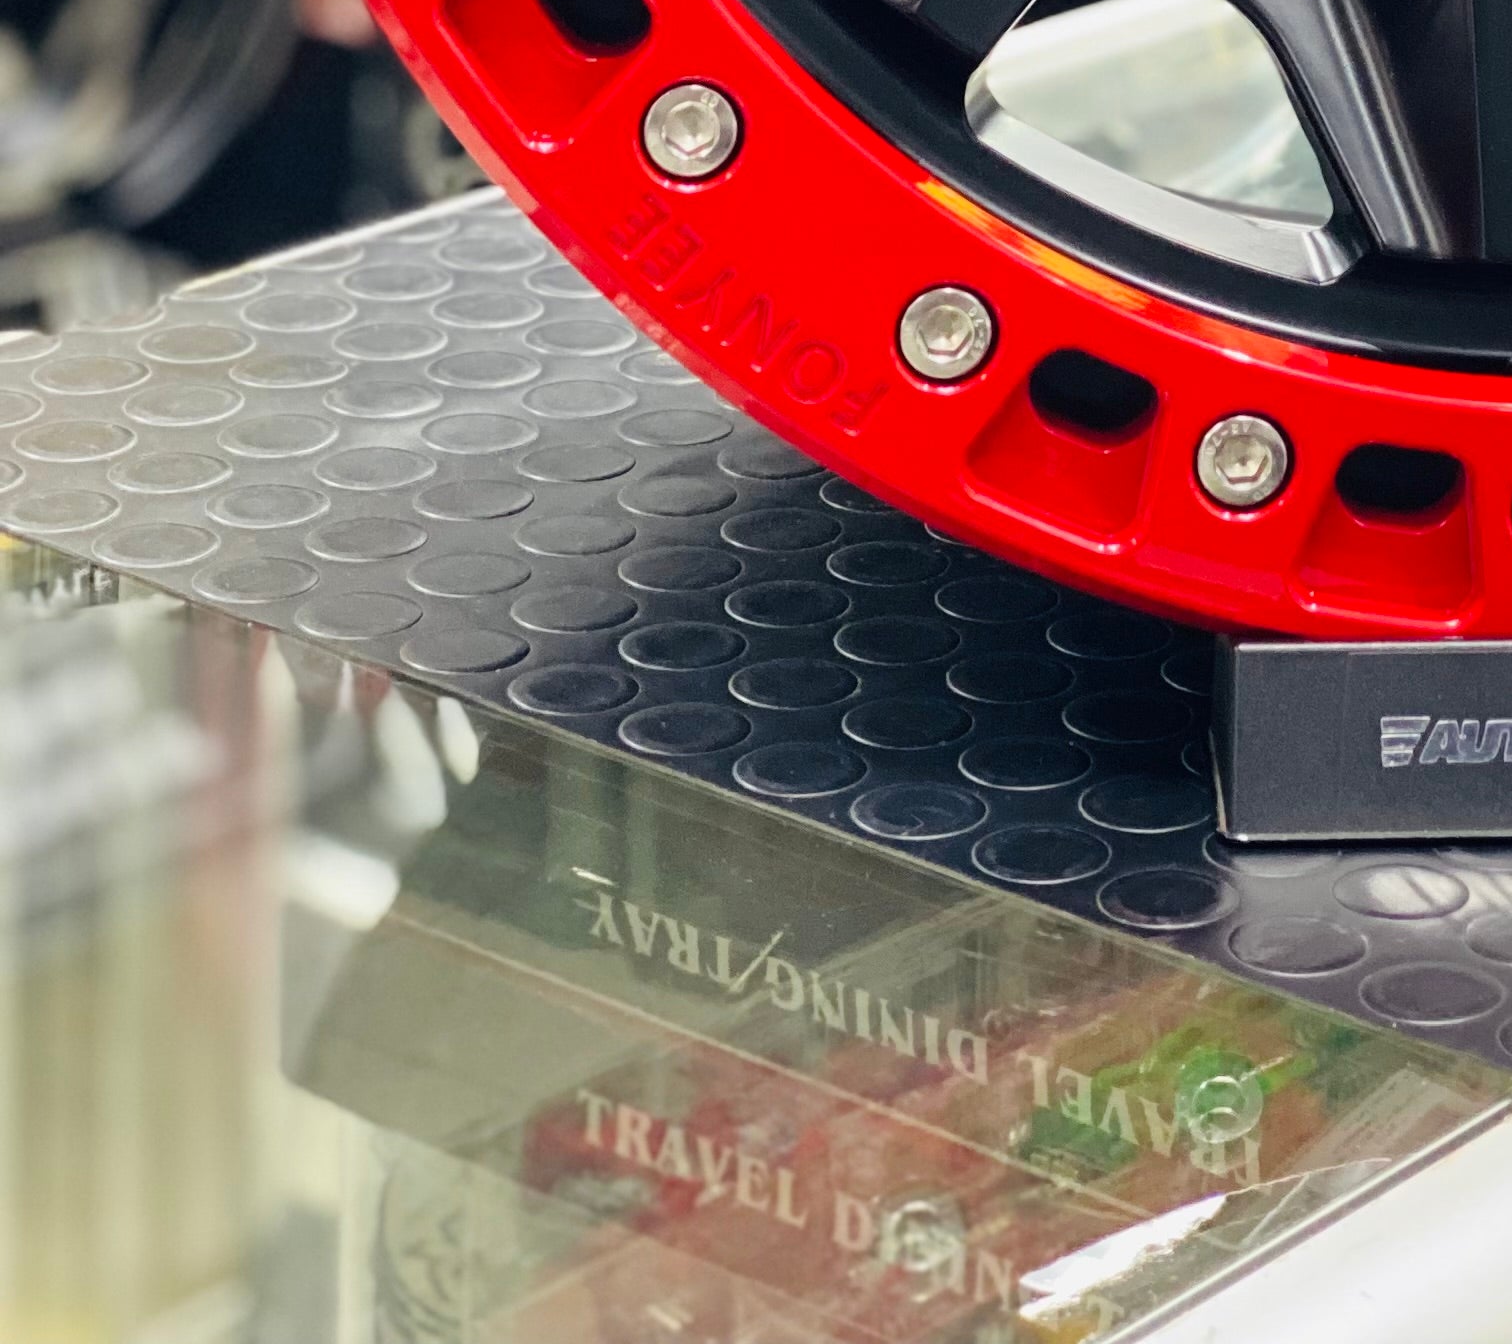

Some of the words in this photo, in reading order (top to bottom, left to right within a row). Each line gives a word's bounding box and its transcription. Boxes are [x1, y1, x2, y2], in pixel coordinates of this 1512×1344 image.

[606, 191, 890, 436] FONYEE
[577, 1089, 806, 1229] TRAVEL
[1017, 1053, 1272, 1195] TRAVEL
